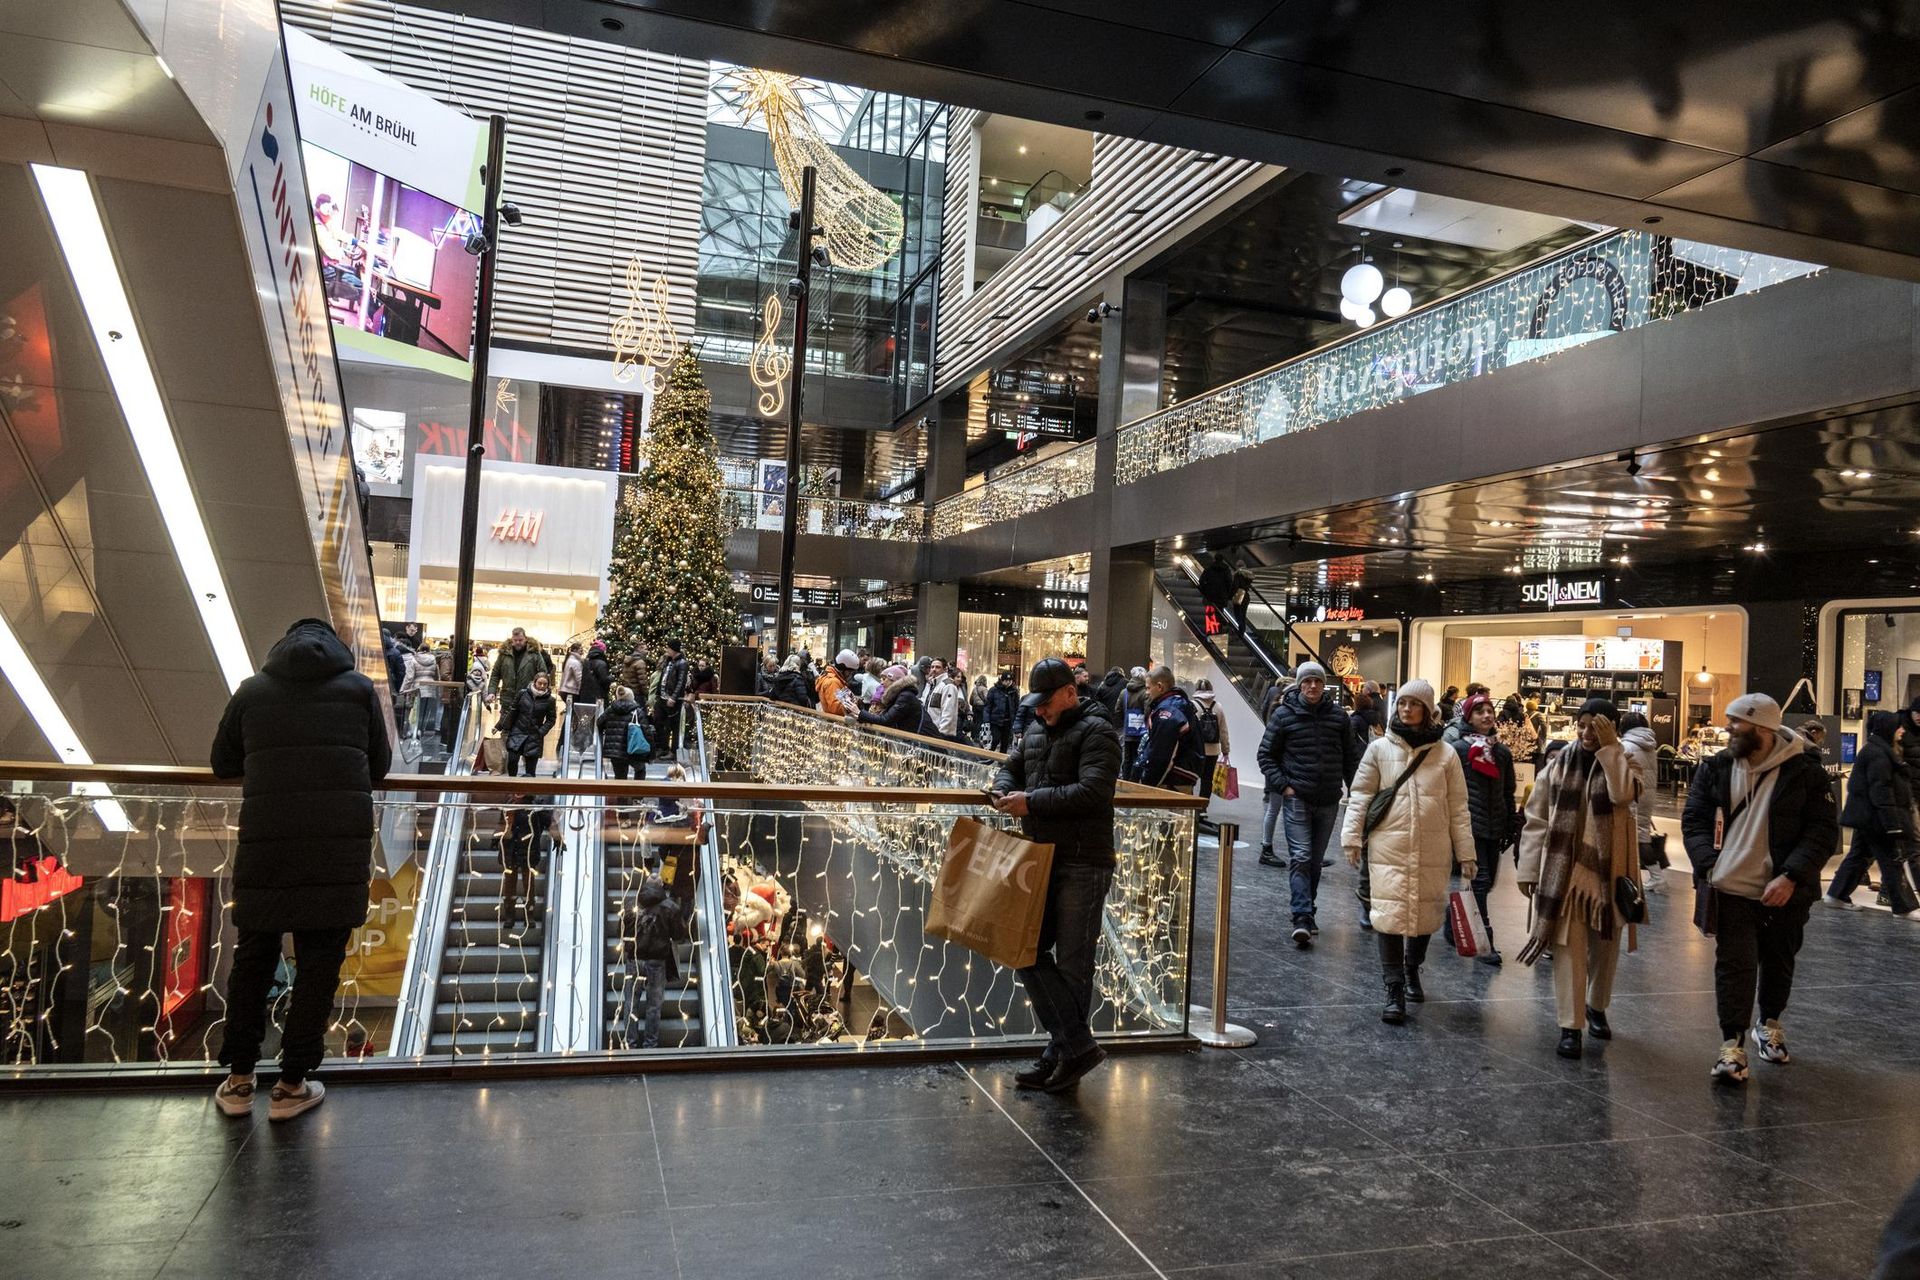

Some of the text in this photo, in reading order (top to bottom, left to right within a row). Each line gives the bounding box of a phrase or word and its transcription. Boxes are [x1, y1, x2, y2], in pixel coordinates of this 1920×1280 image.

[309, 83, 417, 147] HÖFE AM BRÜHL
[271, 161, 332, 460] INTERSPORT
[990, 412, 996, 425] 1
[490, 509, 544, 544] H&M
